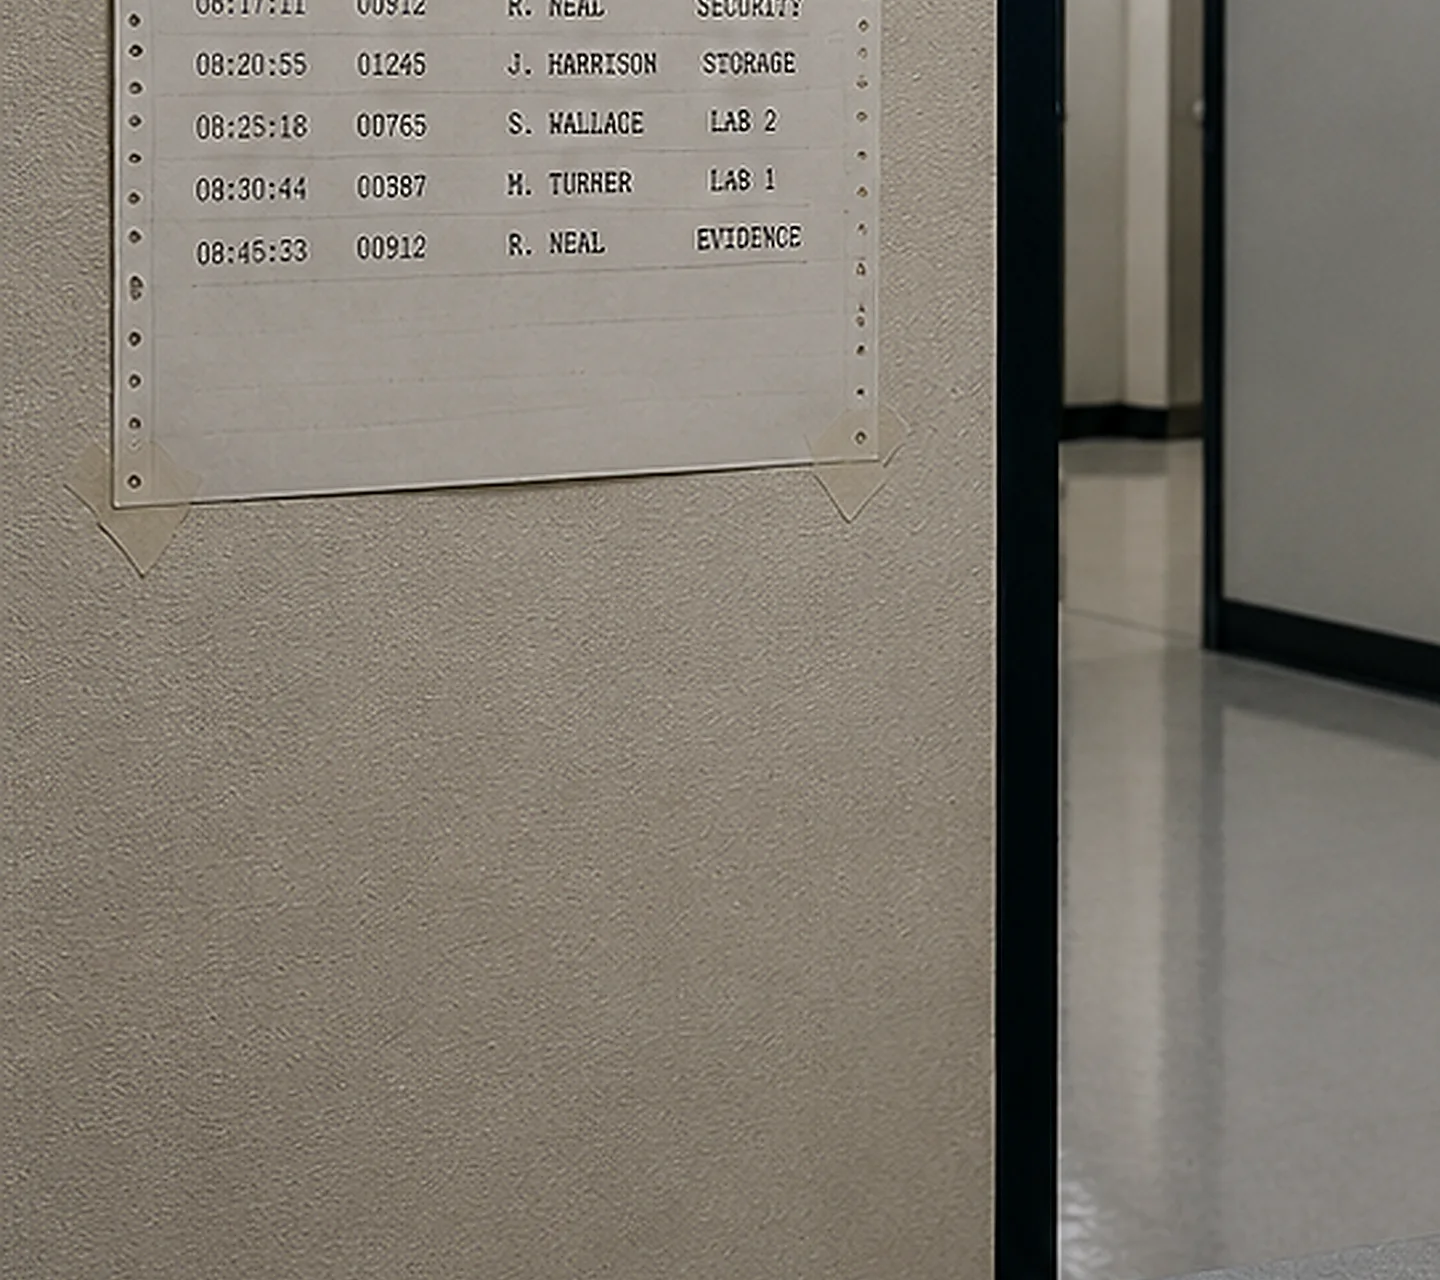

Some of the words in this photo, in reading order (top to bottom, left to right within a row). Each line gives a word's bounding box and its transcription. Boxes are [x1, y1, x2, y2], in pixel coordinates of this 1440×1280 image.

[195, 51, 308, 77] 08:20:55
[357, 51, 427, 77] 01245
[507, 52, 532, 76] J.
[547, 51, 657, 76] HARRISON
[702, 50, 796, 76] STORAGE
[195, 113, 308, 140] 08:25:18
[356, 112, 428, 138] 00765
[508, 111, 532, 136] S.
[548, 110, 645, 135] WALLACE
[710, 108, 752, 133] LAB
[763, 108, 777, 132] 2
[195, 176, 307, 203] 08:30:44
[357, 174, 427, 199] 00387
[507, 172, 532, 196] M.
[548, 170, 633, 196] TURNER
[710, 167, 751, 193] LAB
[765, 167, 775, 191] 1
[196, 238, 308, 267] 08:45:33
[356, 234, 427, 261] 00912
[508, 232, 533, 257] R.
[549, 230, 606, 255] NEAL
[697, 225, 802, 251] EVIDENCE
